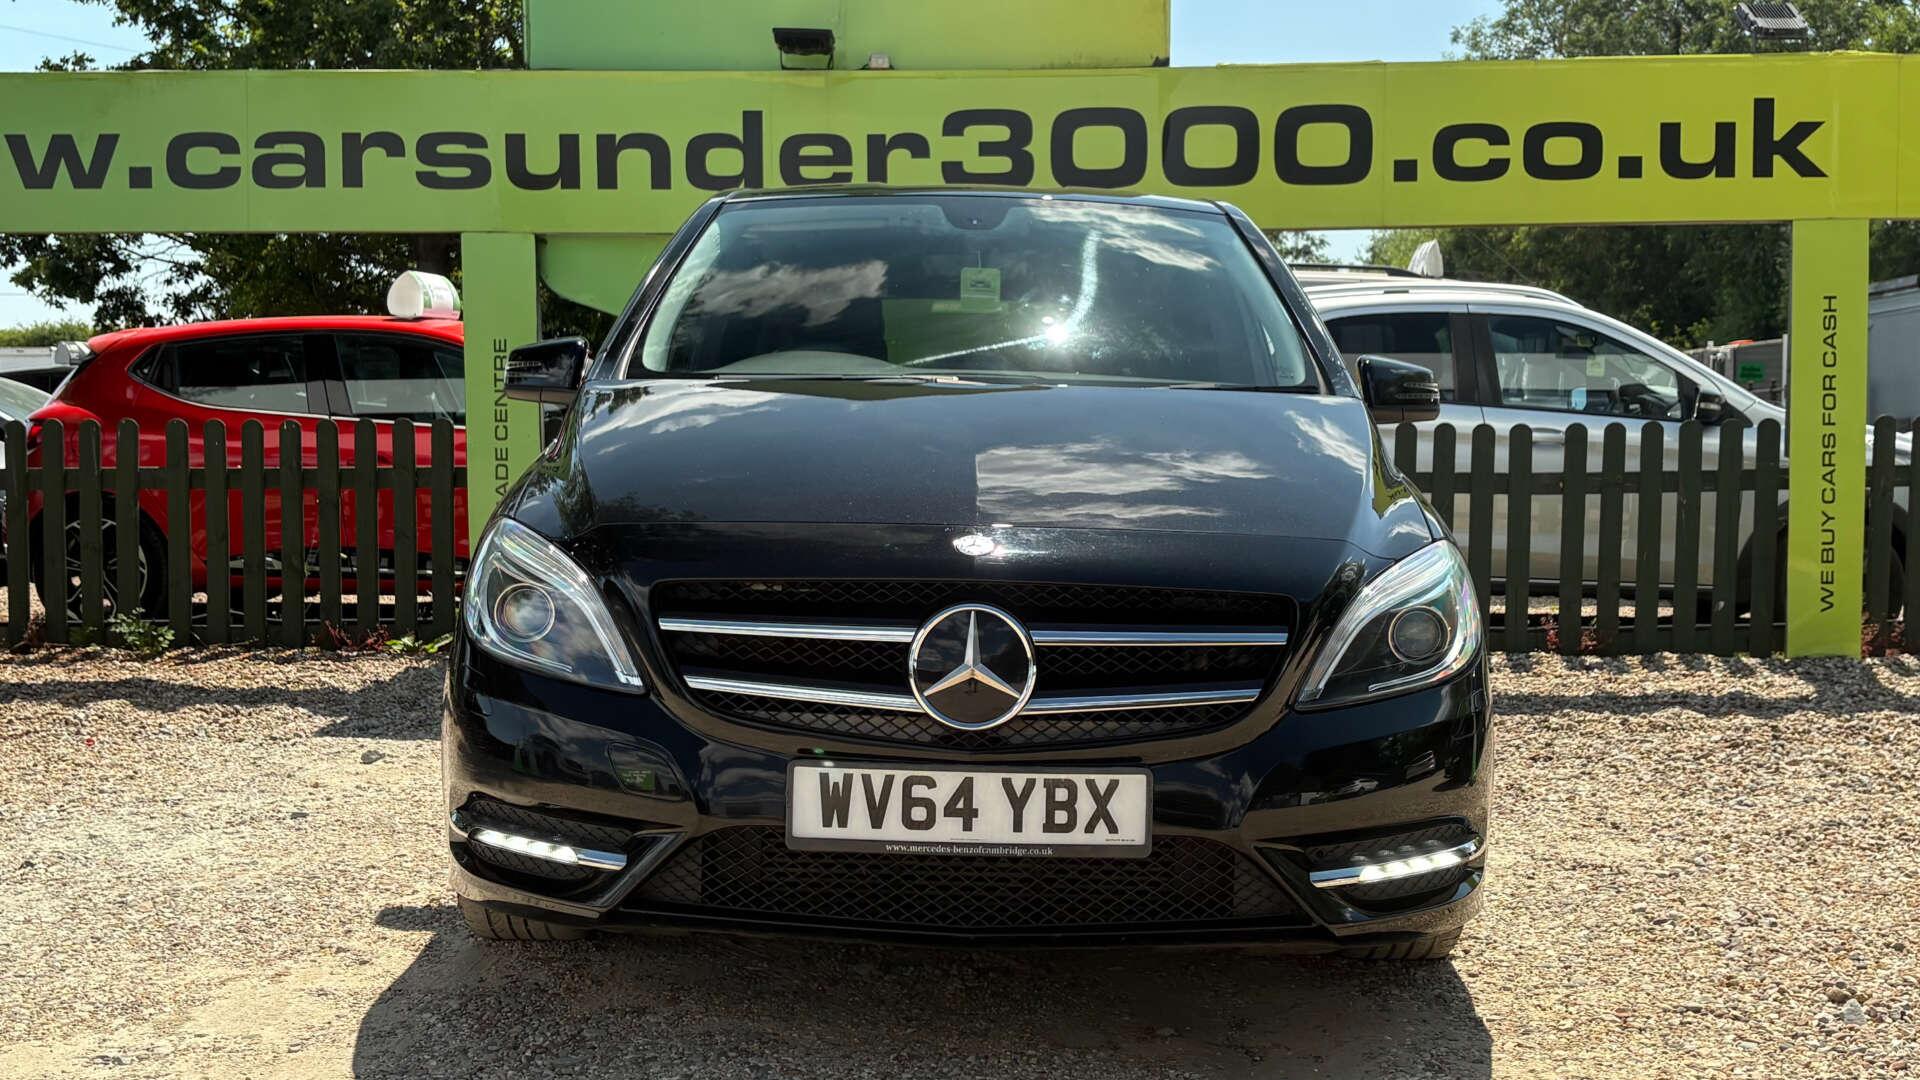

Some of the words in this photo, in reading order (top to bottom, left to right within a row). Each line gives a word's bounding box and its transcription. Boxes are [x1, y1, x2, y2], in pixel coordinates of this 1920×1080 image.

[4, 97, 1829, 191] w.carsunder3000.co.uk
[1822, 295, 1838, 368] CASH
[493, 338, 509, 442] CENTRE
[1822, 374, 1837, 426] FOR
[495, 447, 509, 504] ADE
[1821, 432, 1837, 505] CARS
[1820, 510, 1836, 564] BUY
[1819, 570, 1835, 613] WE
[818, 771, 980, 833] WV64
[1000, 776, 1121, 835] YBX
[885, 843, 1054, 856] www.mercedes-benzofcambridge.co.uk
